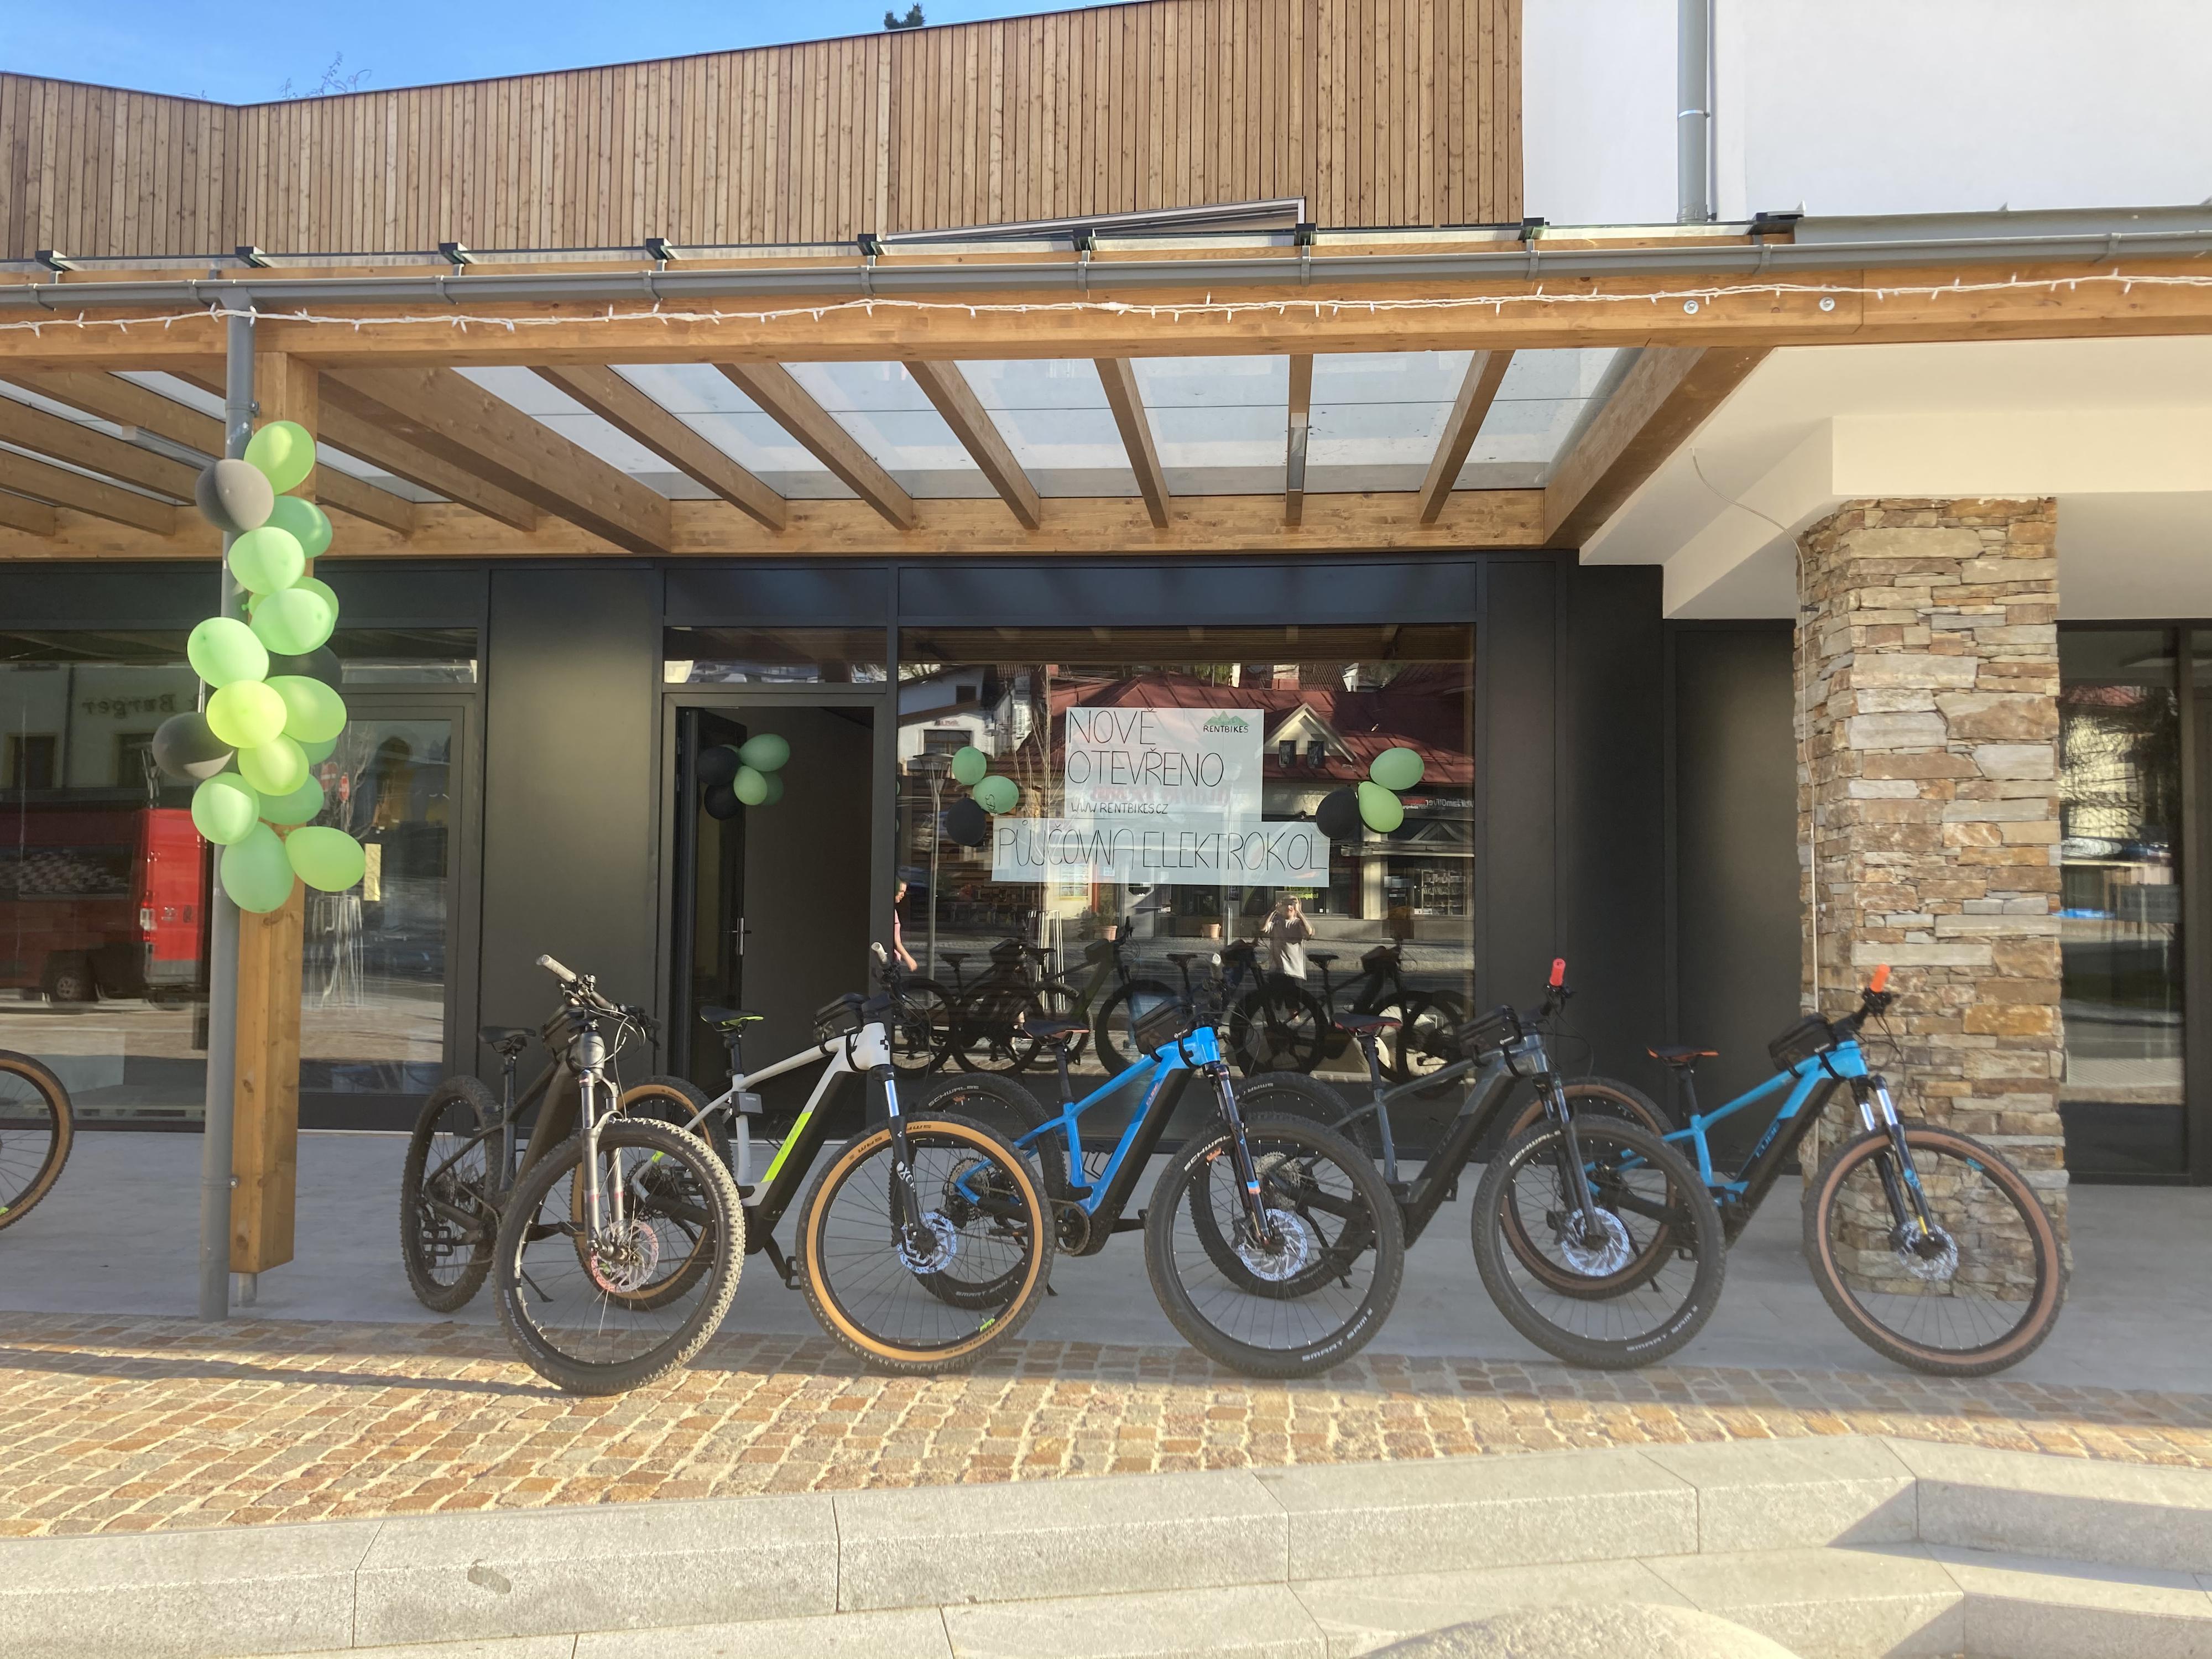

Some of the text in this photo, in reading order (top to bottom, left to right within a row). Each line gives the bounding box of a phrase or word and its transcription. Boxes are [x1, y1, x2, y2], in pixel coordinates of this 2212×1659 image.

[1069, 707, 1157, 744] NOVĚ
[1203, 725, 1249, 733] RENTBIKES
[1068, 748, 1224, 787] OTEVŘENO
[999, 820, 1328, 872] PŮJČOVNA ELEKTROKOL
[928, 1086, 979, 1107] SCHWALBE
[1302, 1316, 1368, 1361] SMART SAM
